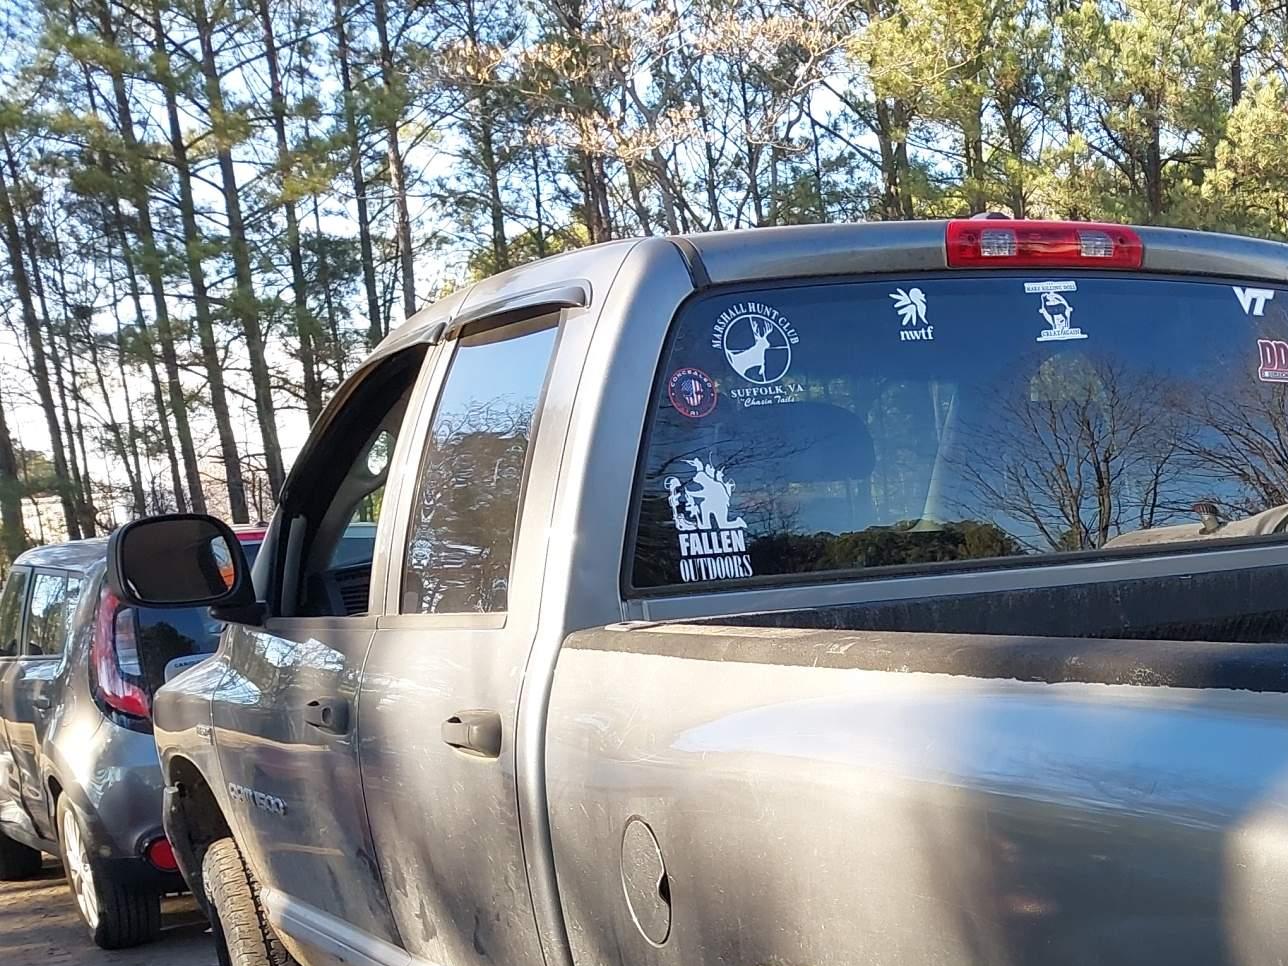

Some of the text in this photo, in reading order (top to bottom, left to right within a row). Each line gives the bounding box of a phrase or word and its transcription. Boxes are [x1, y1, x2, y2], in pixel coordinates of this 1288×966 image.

[1232, 286, 1275, 316] VT
[712, 302, 800, 350] MARSHALL HUNT CLUB
[900, 326, 934, 341] nwtf
[731, 384, 804, 398] SUFFOLK, VA
[678, 530, 746, 557] FALLEN
[680, 554, 753, 583] OUTDOORS
